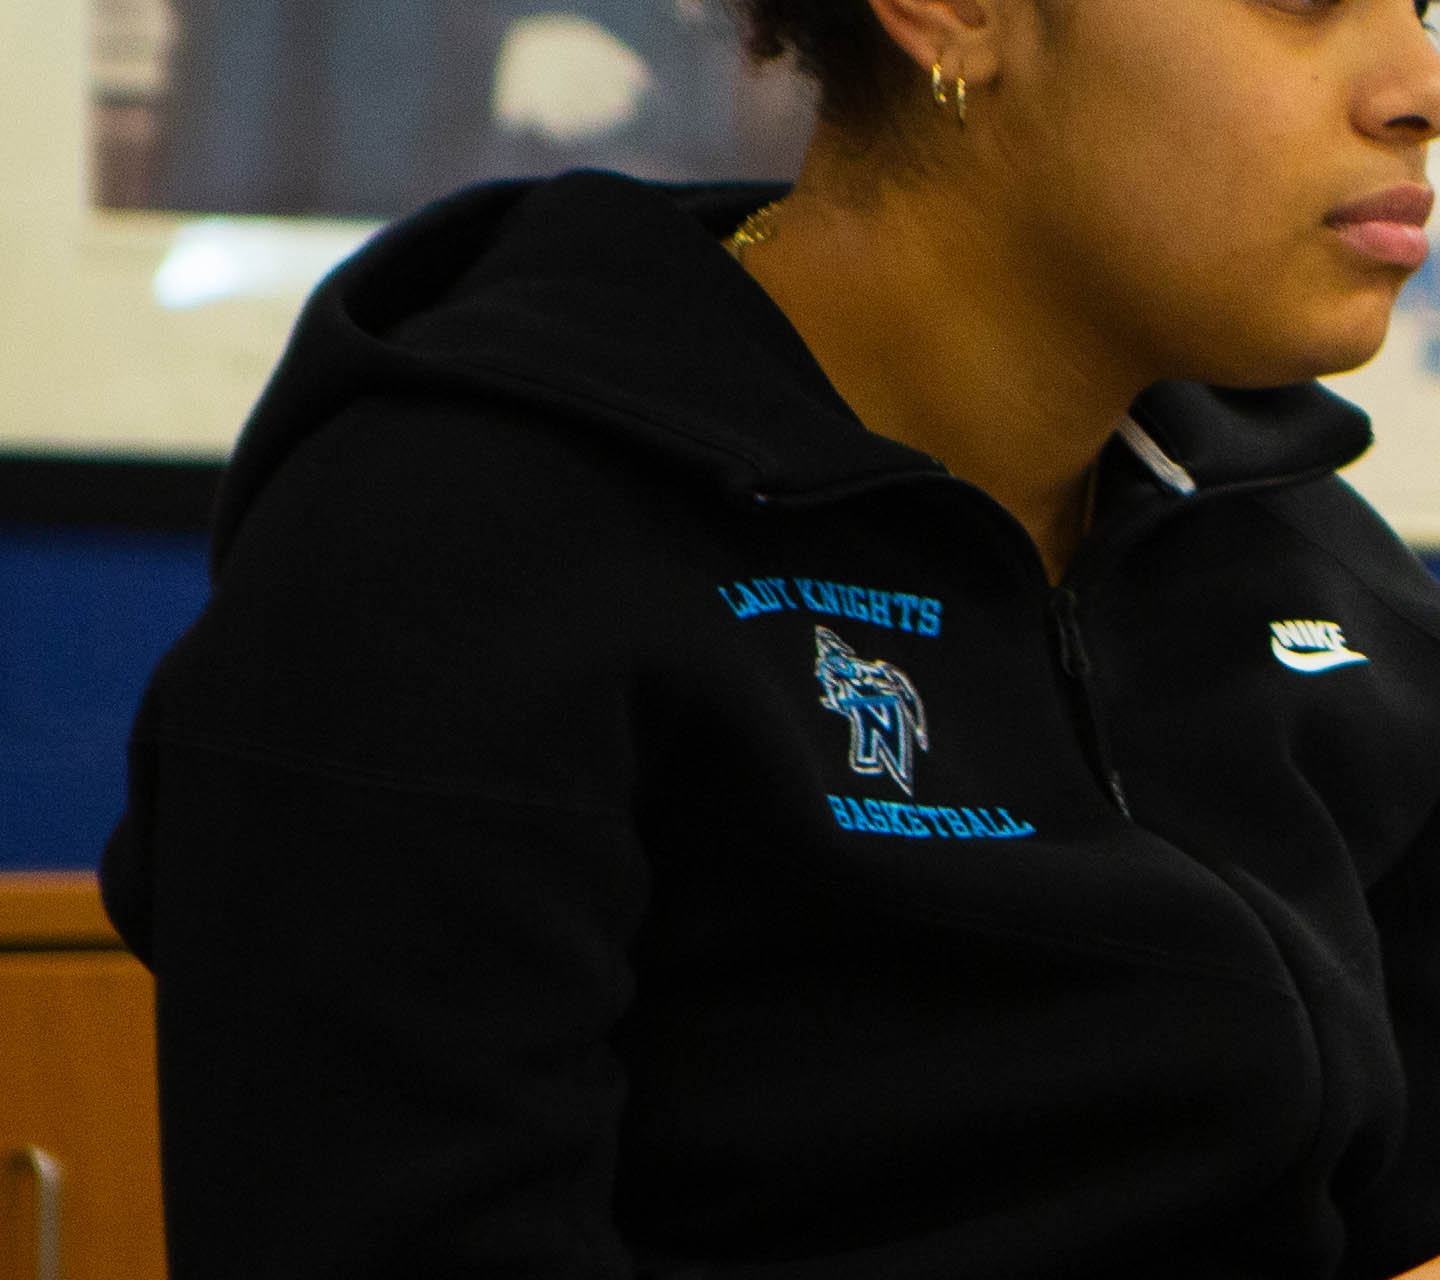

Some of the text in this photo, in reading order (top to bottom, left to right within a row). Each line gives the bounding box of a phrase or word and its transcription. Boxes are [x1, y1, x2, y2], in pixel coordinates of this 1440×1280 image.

[717, 577, 943, 638] LADY KNIGHTS
[1269, 619, 1347, 651] NIKE
[826, 794, 1037, 839] BASKETBALL
